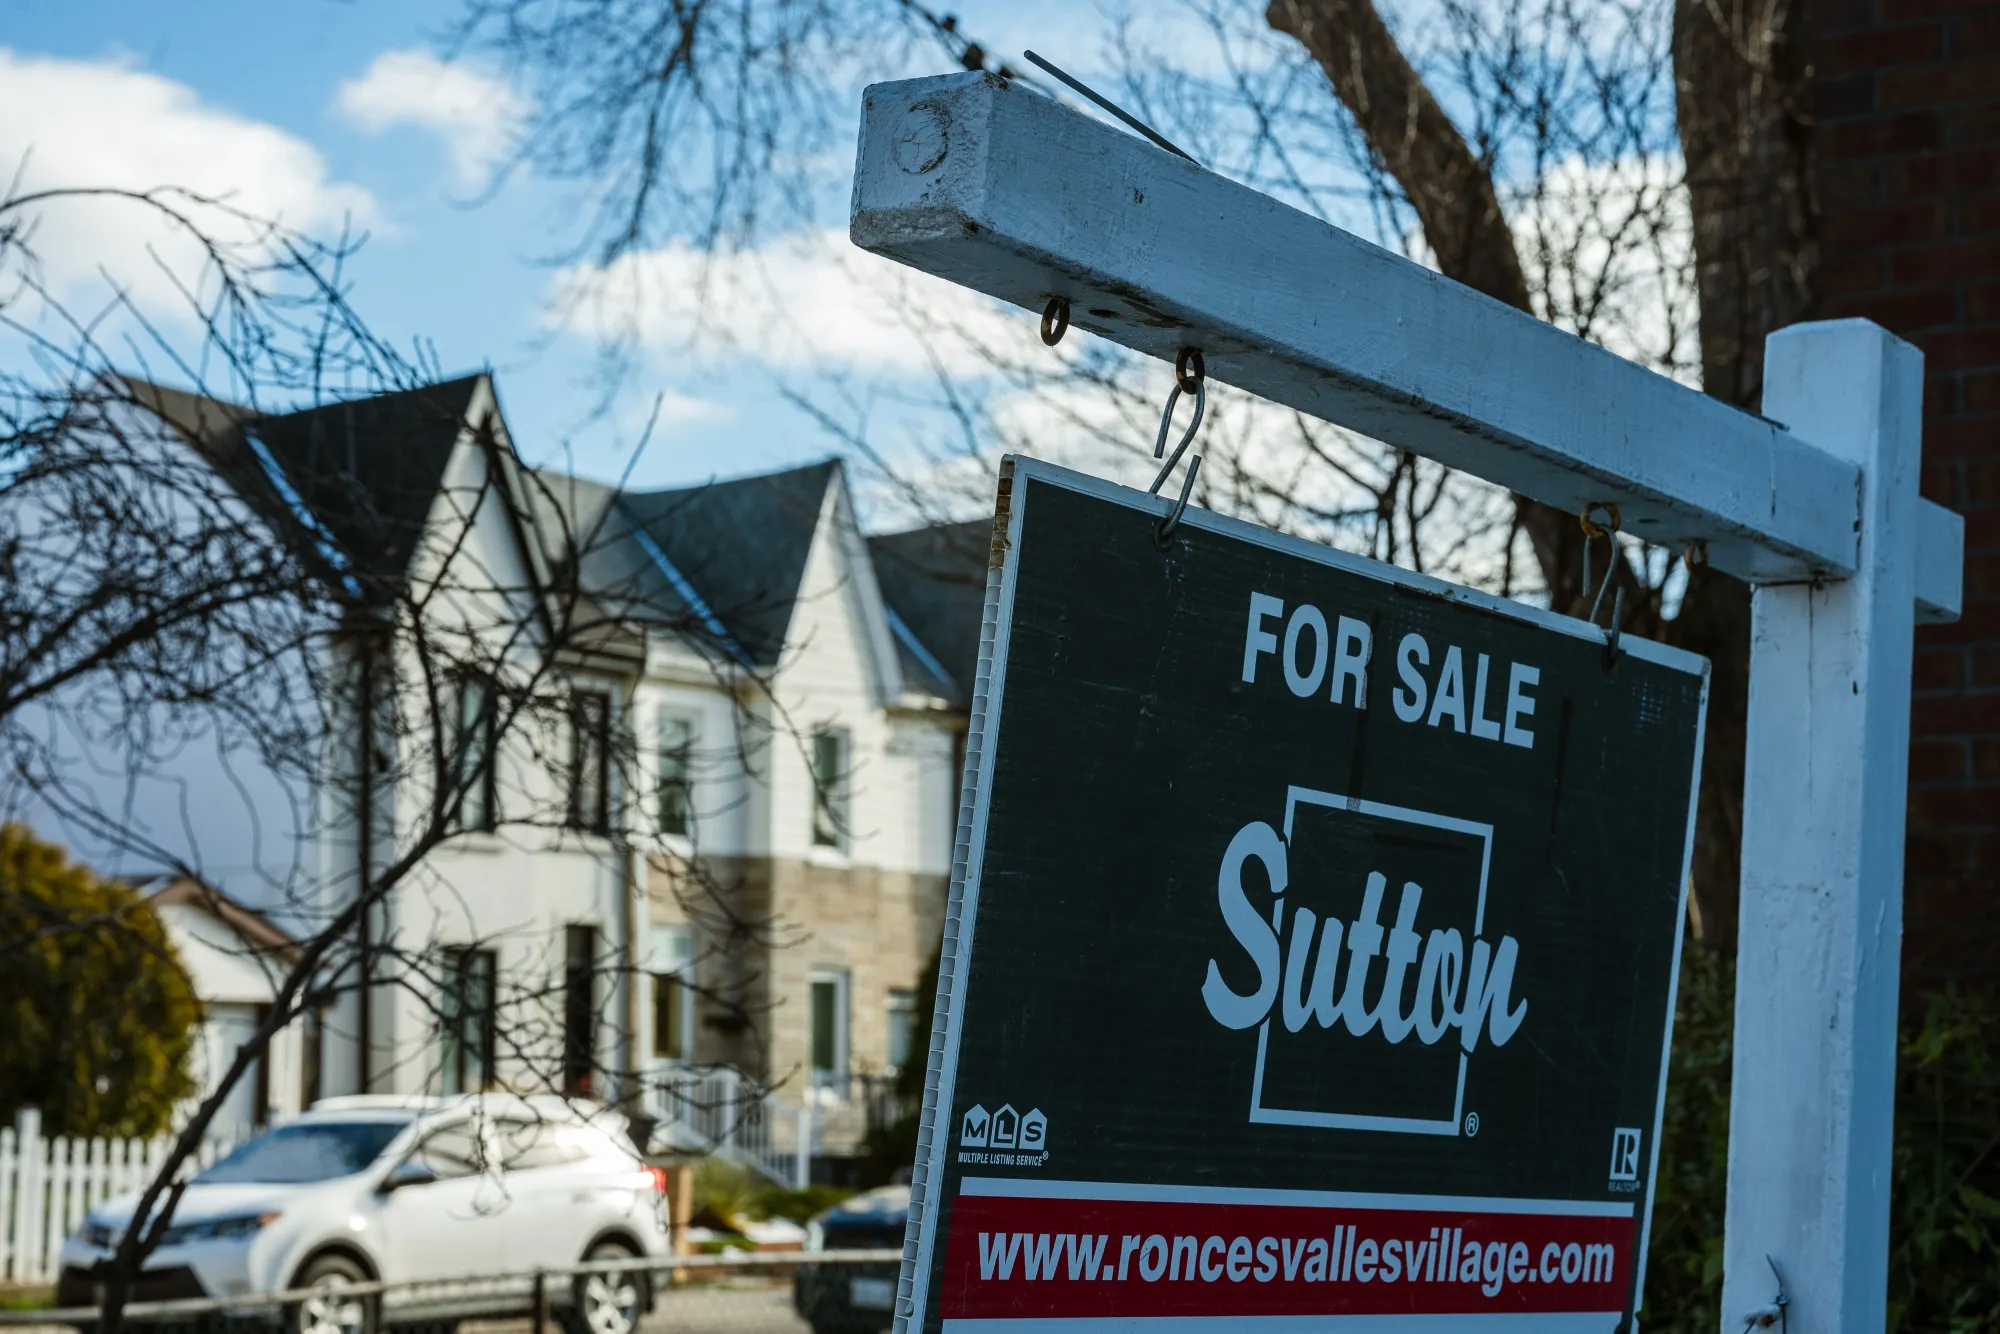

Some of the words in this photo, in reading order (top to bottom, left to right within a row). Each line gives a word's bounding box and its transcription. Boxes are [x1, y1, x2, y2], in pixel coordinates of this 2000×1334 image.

[1242, 591, 1373, 710] FOR
[1392, 632, 1541, 749] SALE
[1201, 821, 1528, 1053] Sutton
[958, 1151, 989, 1164] MULTIPLE
[990, 1153, 1015, 1165] LISTING
[964, 1117, 1043, 1143] MLS
[977, 1225, 1615, 1298] www.roncesvallesvillage.com
